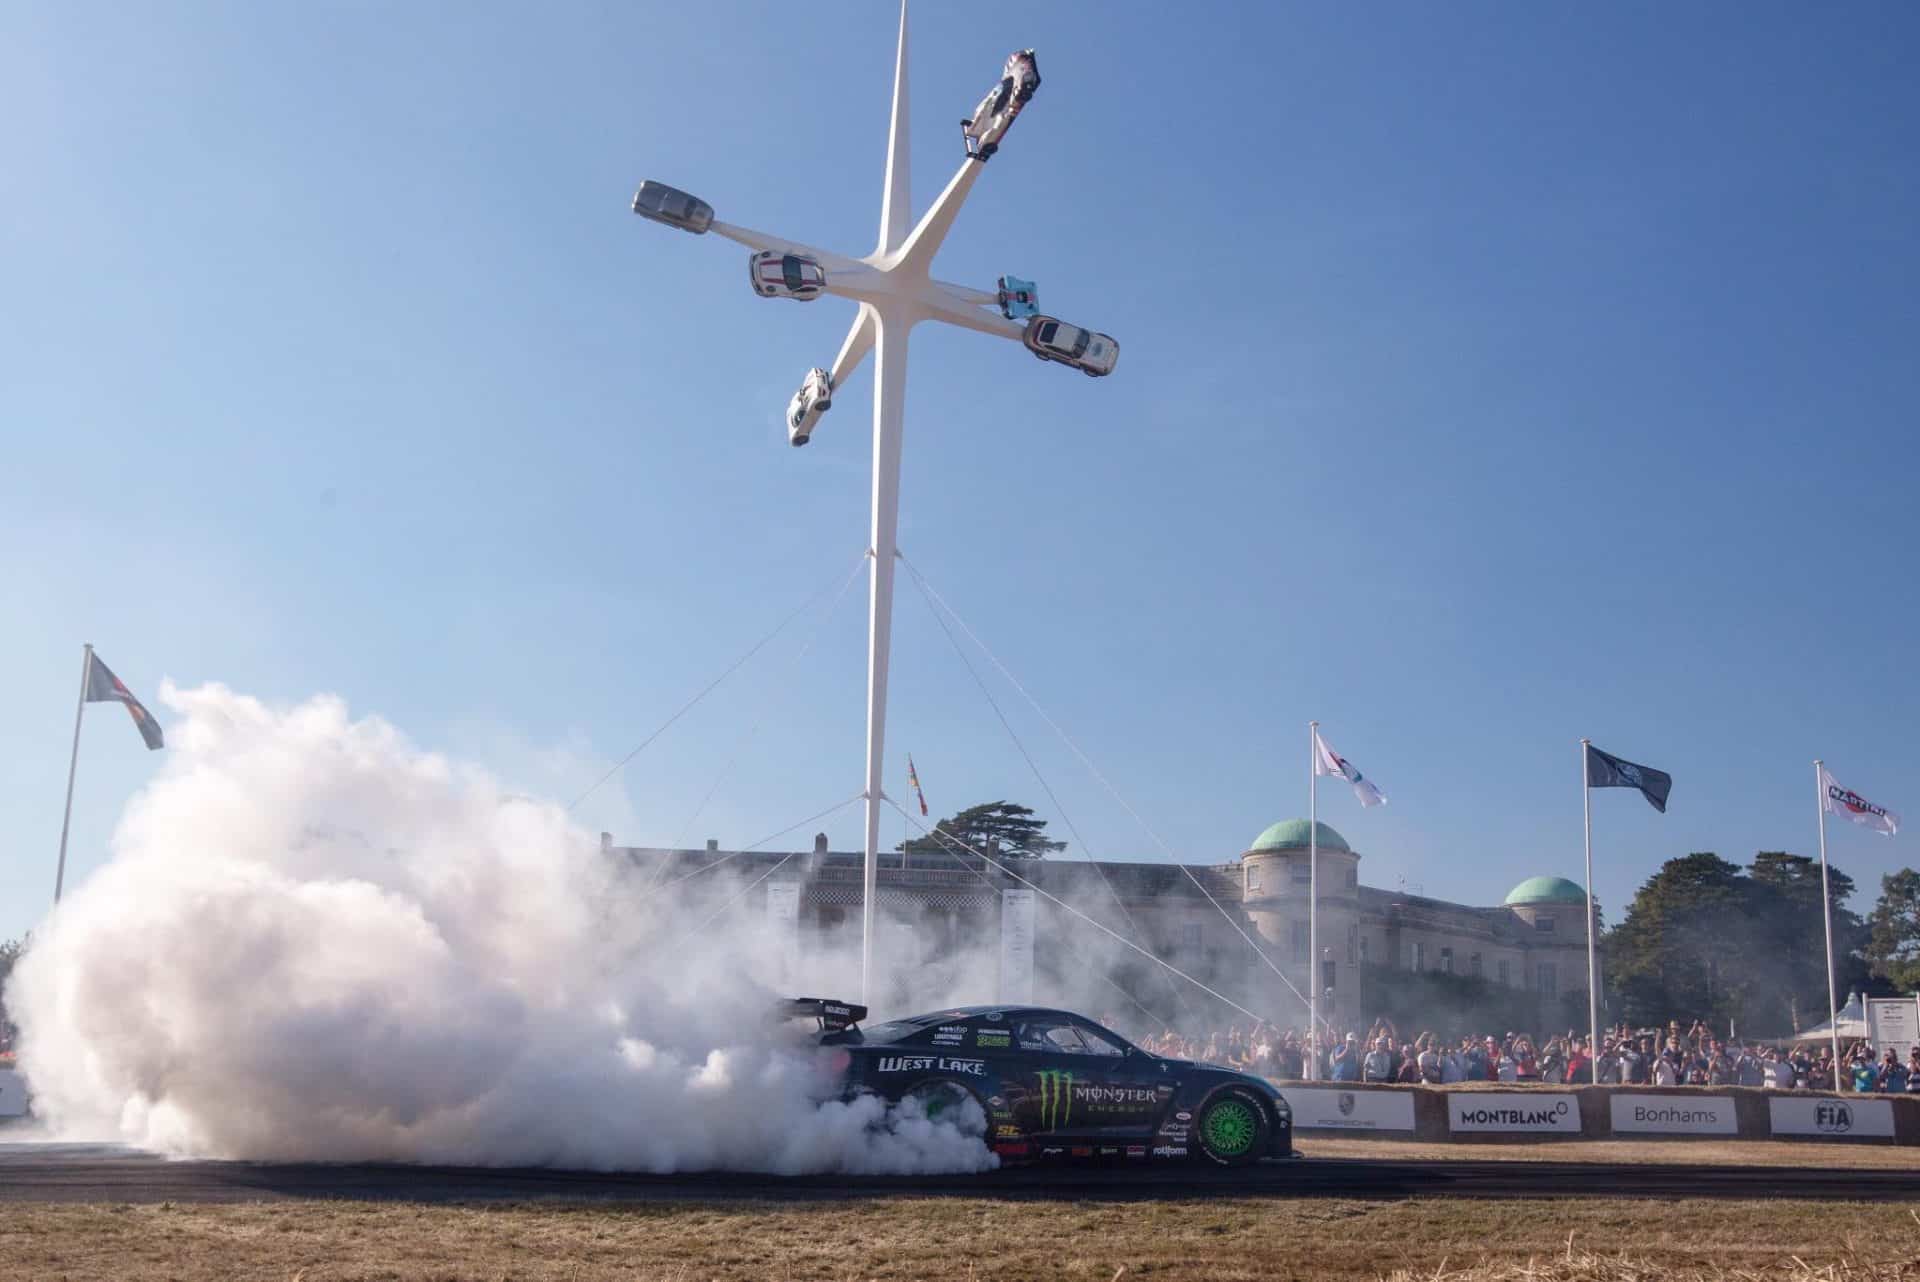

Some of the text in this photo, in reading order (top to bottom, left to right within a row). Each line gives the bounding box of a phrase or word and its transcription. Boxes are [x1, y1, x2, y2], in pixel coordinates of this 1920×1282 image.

[878, 1056, 985, 1076] WEST LAKE
[1075, 1085, 1157, 1103] MONSTER
[1462, 1110, 1557, 1125] MONTBLANC
[1635, 1106, 1717, 1124] Bonhams
